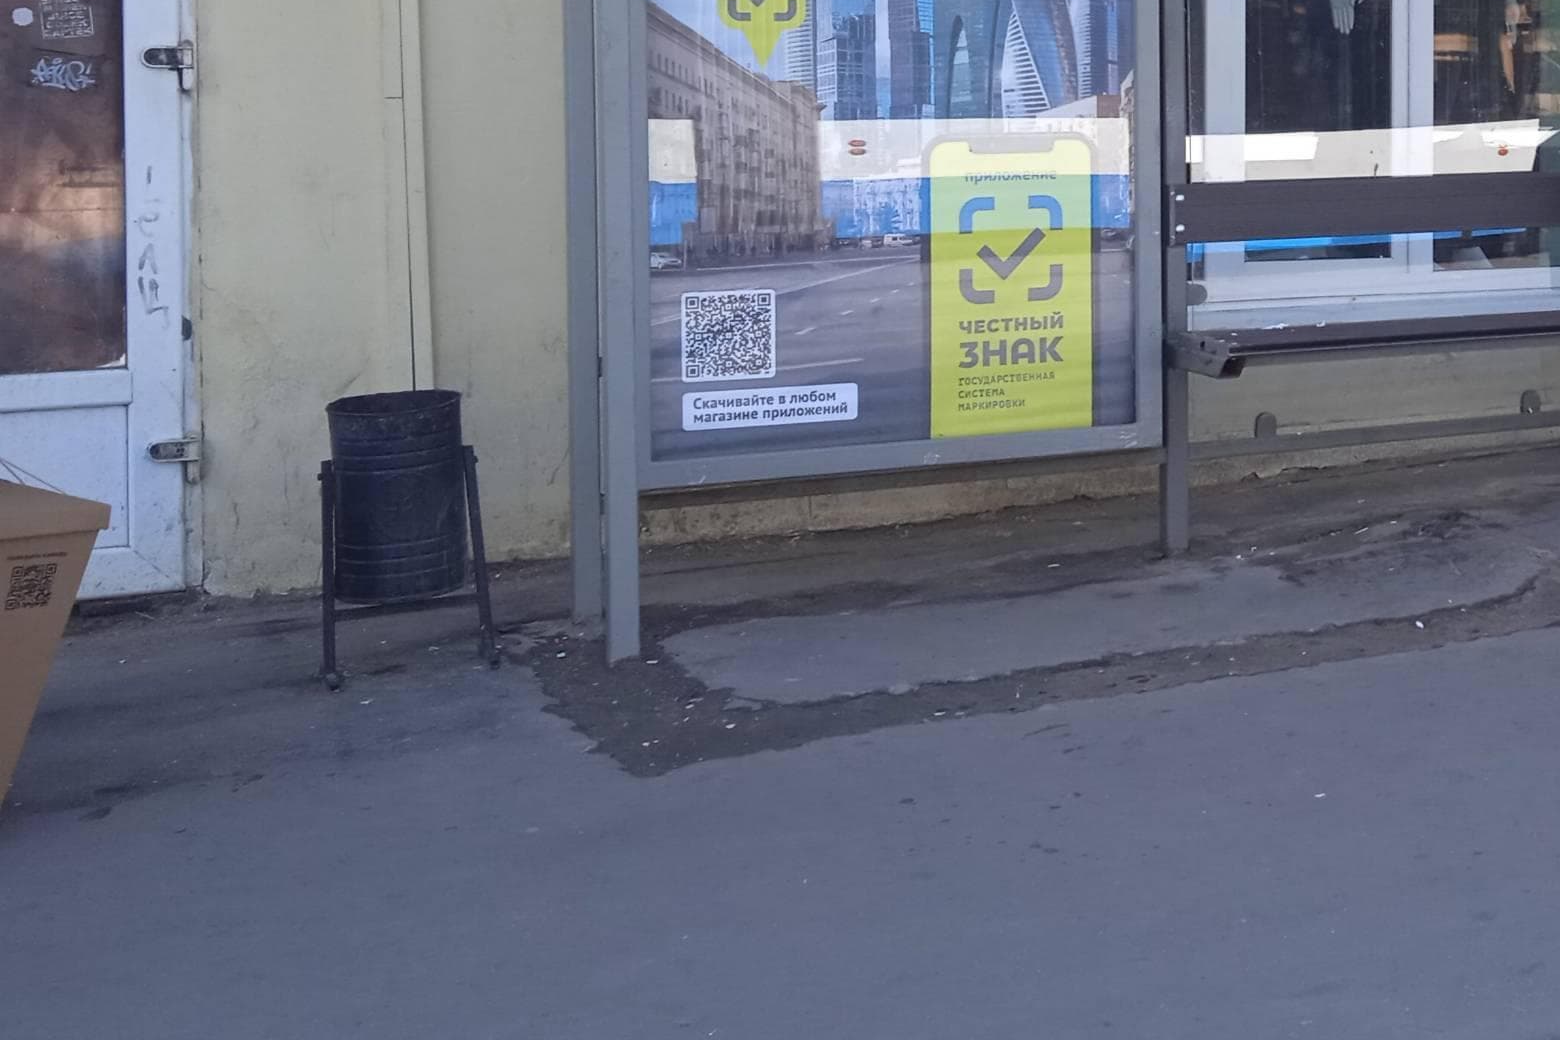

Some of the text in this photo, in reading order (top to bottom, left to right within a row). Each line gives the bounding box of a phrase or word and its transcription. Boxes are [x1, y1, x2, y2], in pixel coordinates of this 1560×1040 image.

[958, 311, 1064, 334] ЧЕСТНЫЙ
[958, 335, 1064, 369] ЗНАК
[958, 371, 1056, 387] ГОСУДАРСТВЕННАЯ
[692, 390, 836, 410] Скачивайте в любом
[958, 388, 1005, 399] СИСТЕМА
[693, 402, 849, 424] магазине приложений
[958, 399, 1026, 412] МАРКИРОВКИ
